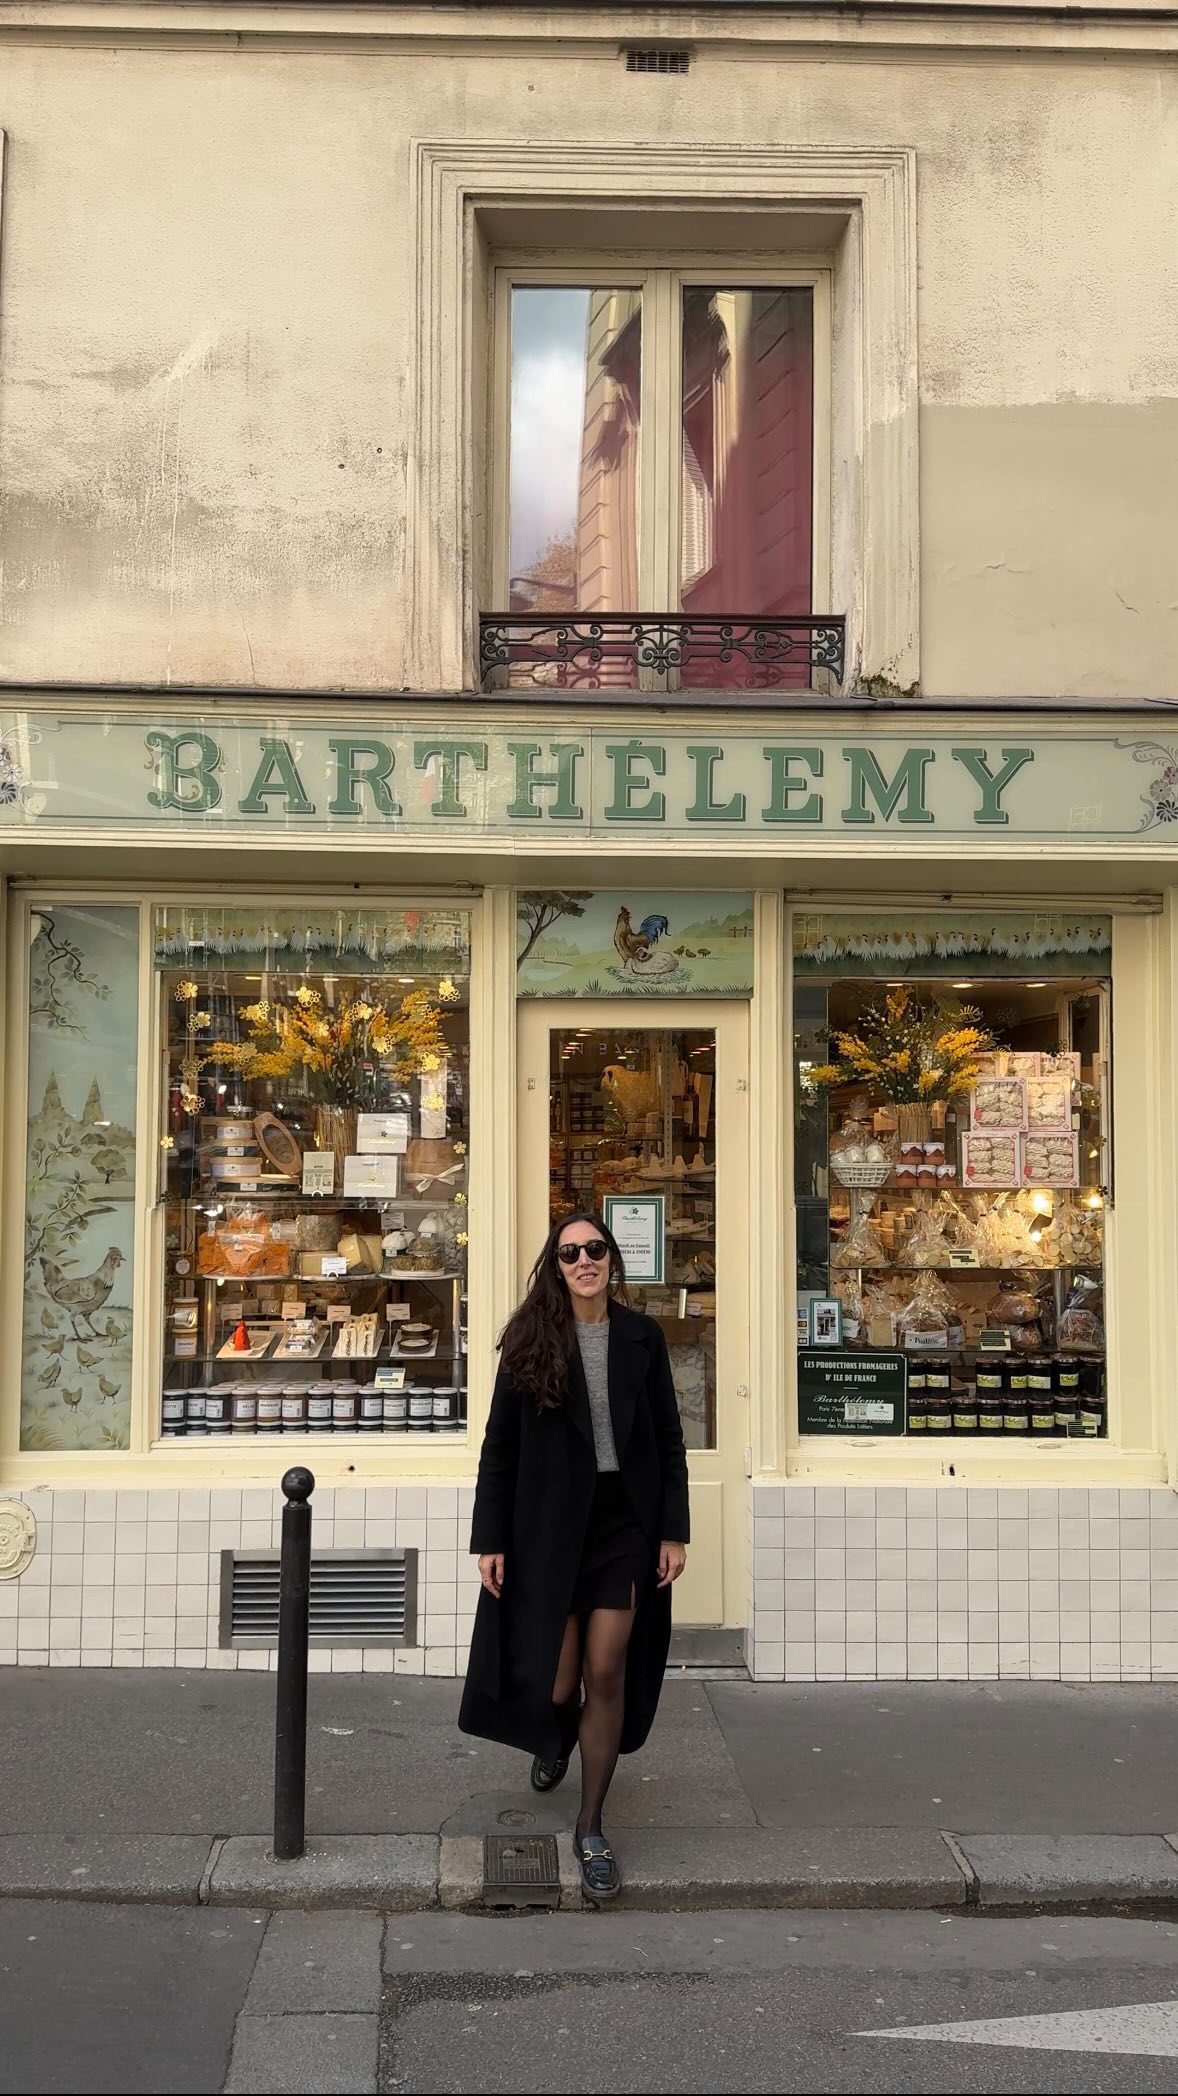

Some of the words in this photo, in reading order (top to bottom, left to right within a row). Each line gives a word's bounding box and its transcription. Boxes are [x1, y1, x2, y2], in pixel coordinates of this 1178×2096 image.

[145, 731, 1034, 825] BARTHÉLEMY
[803, 1360, 815, 1369] LES
[815, 1361, 858, 1370] PRODUCTIONS
[858, 1362, 898, 1371] FROMAGERES
[833, 1374, 843, 1382] ILE
[844, 1374, 853, 1382] DE
[853, 1374, 877, 1383] FRANCE
